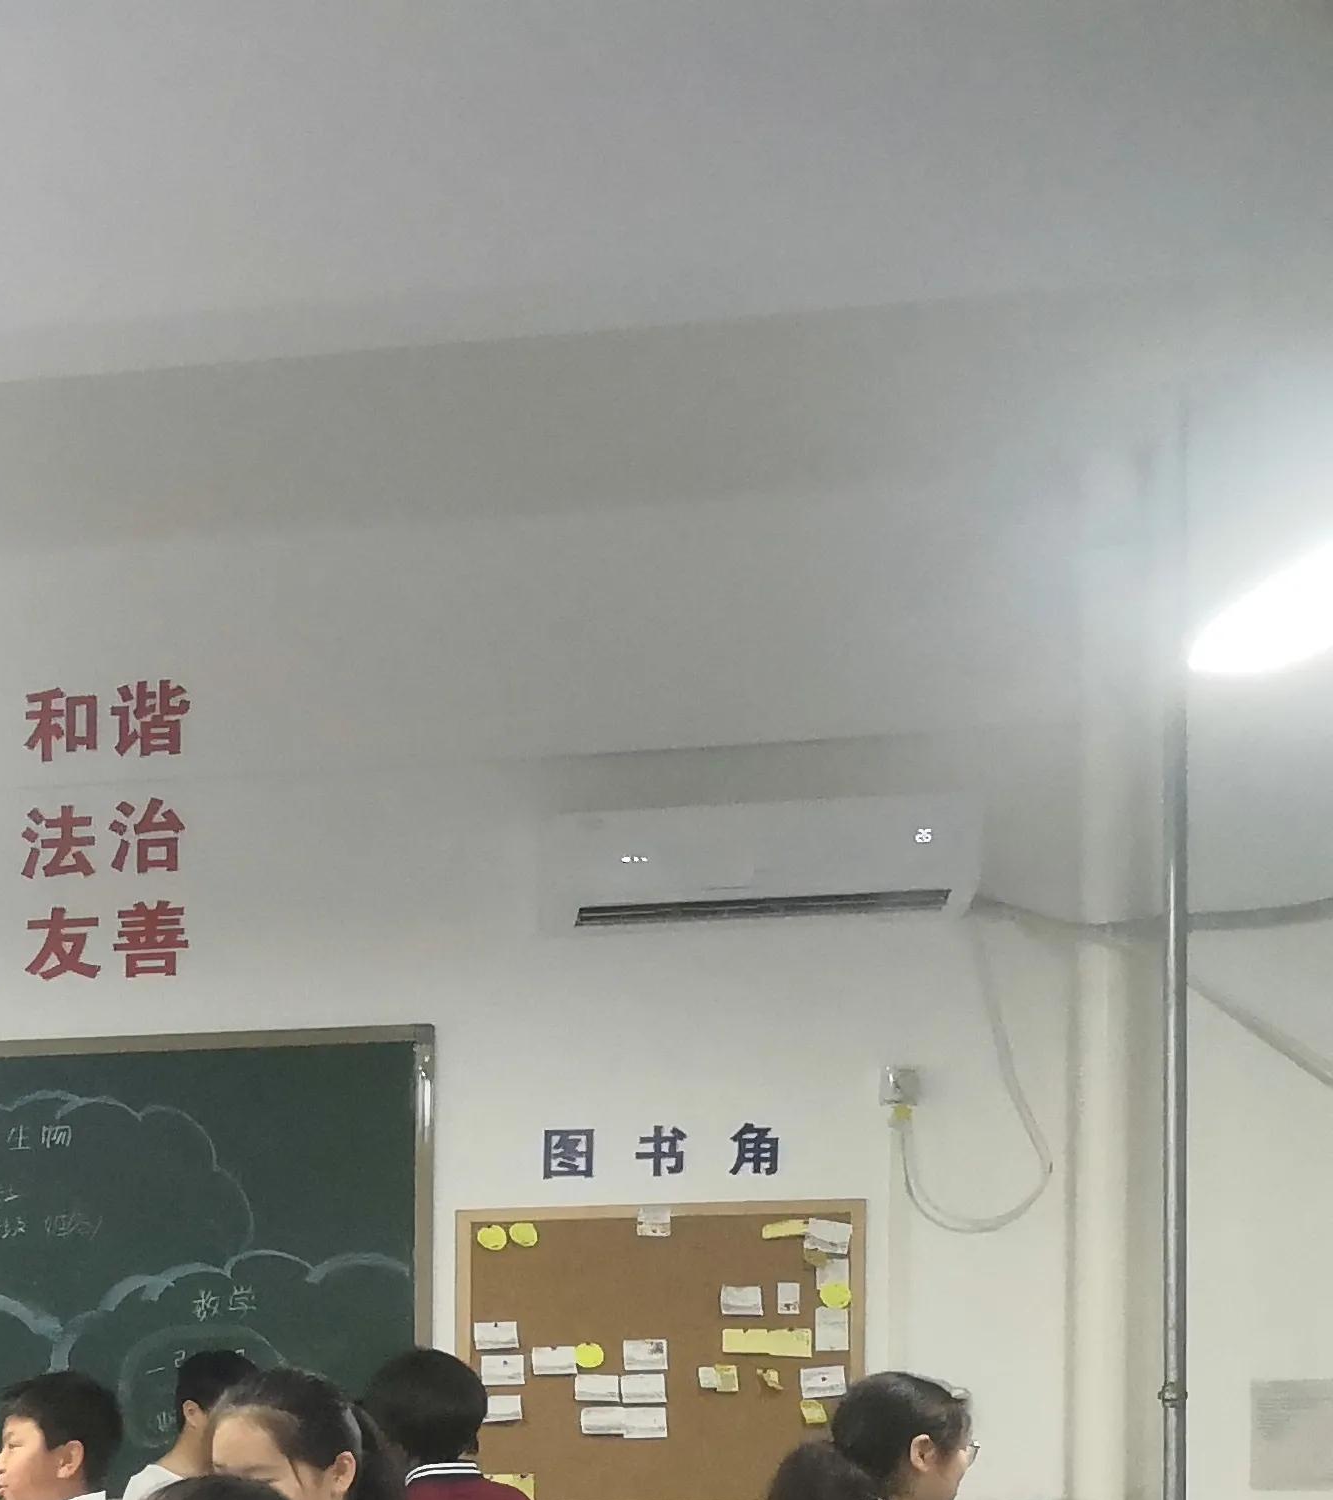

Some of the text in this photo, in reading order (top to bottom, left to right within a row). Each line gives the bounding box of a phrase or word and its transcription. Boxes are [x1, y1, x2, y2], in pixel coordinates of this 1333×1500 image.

[24, 680, 190, 762] 和谐
[21, 798, 185, 881] 法治
[25, 900, 190, 982] 友善
[6, 1124, 72, 1150] 生物
[543, 1122, 779, 1179] 图书角
[192, 1284, 257, 1322] 数学
